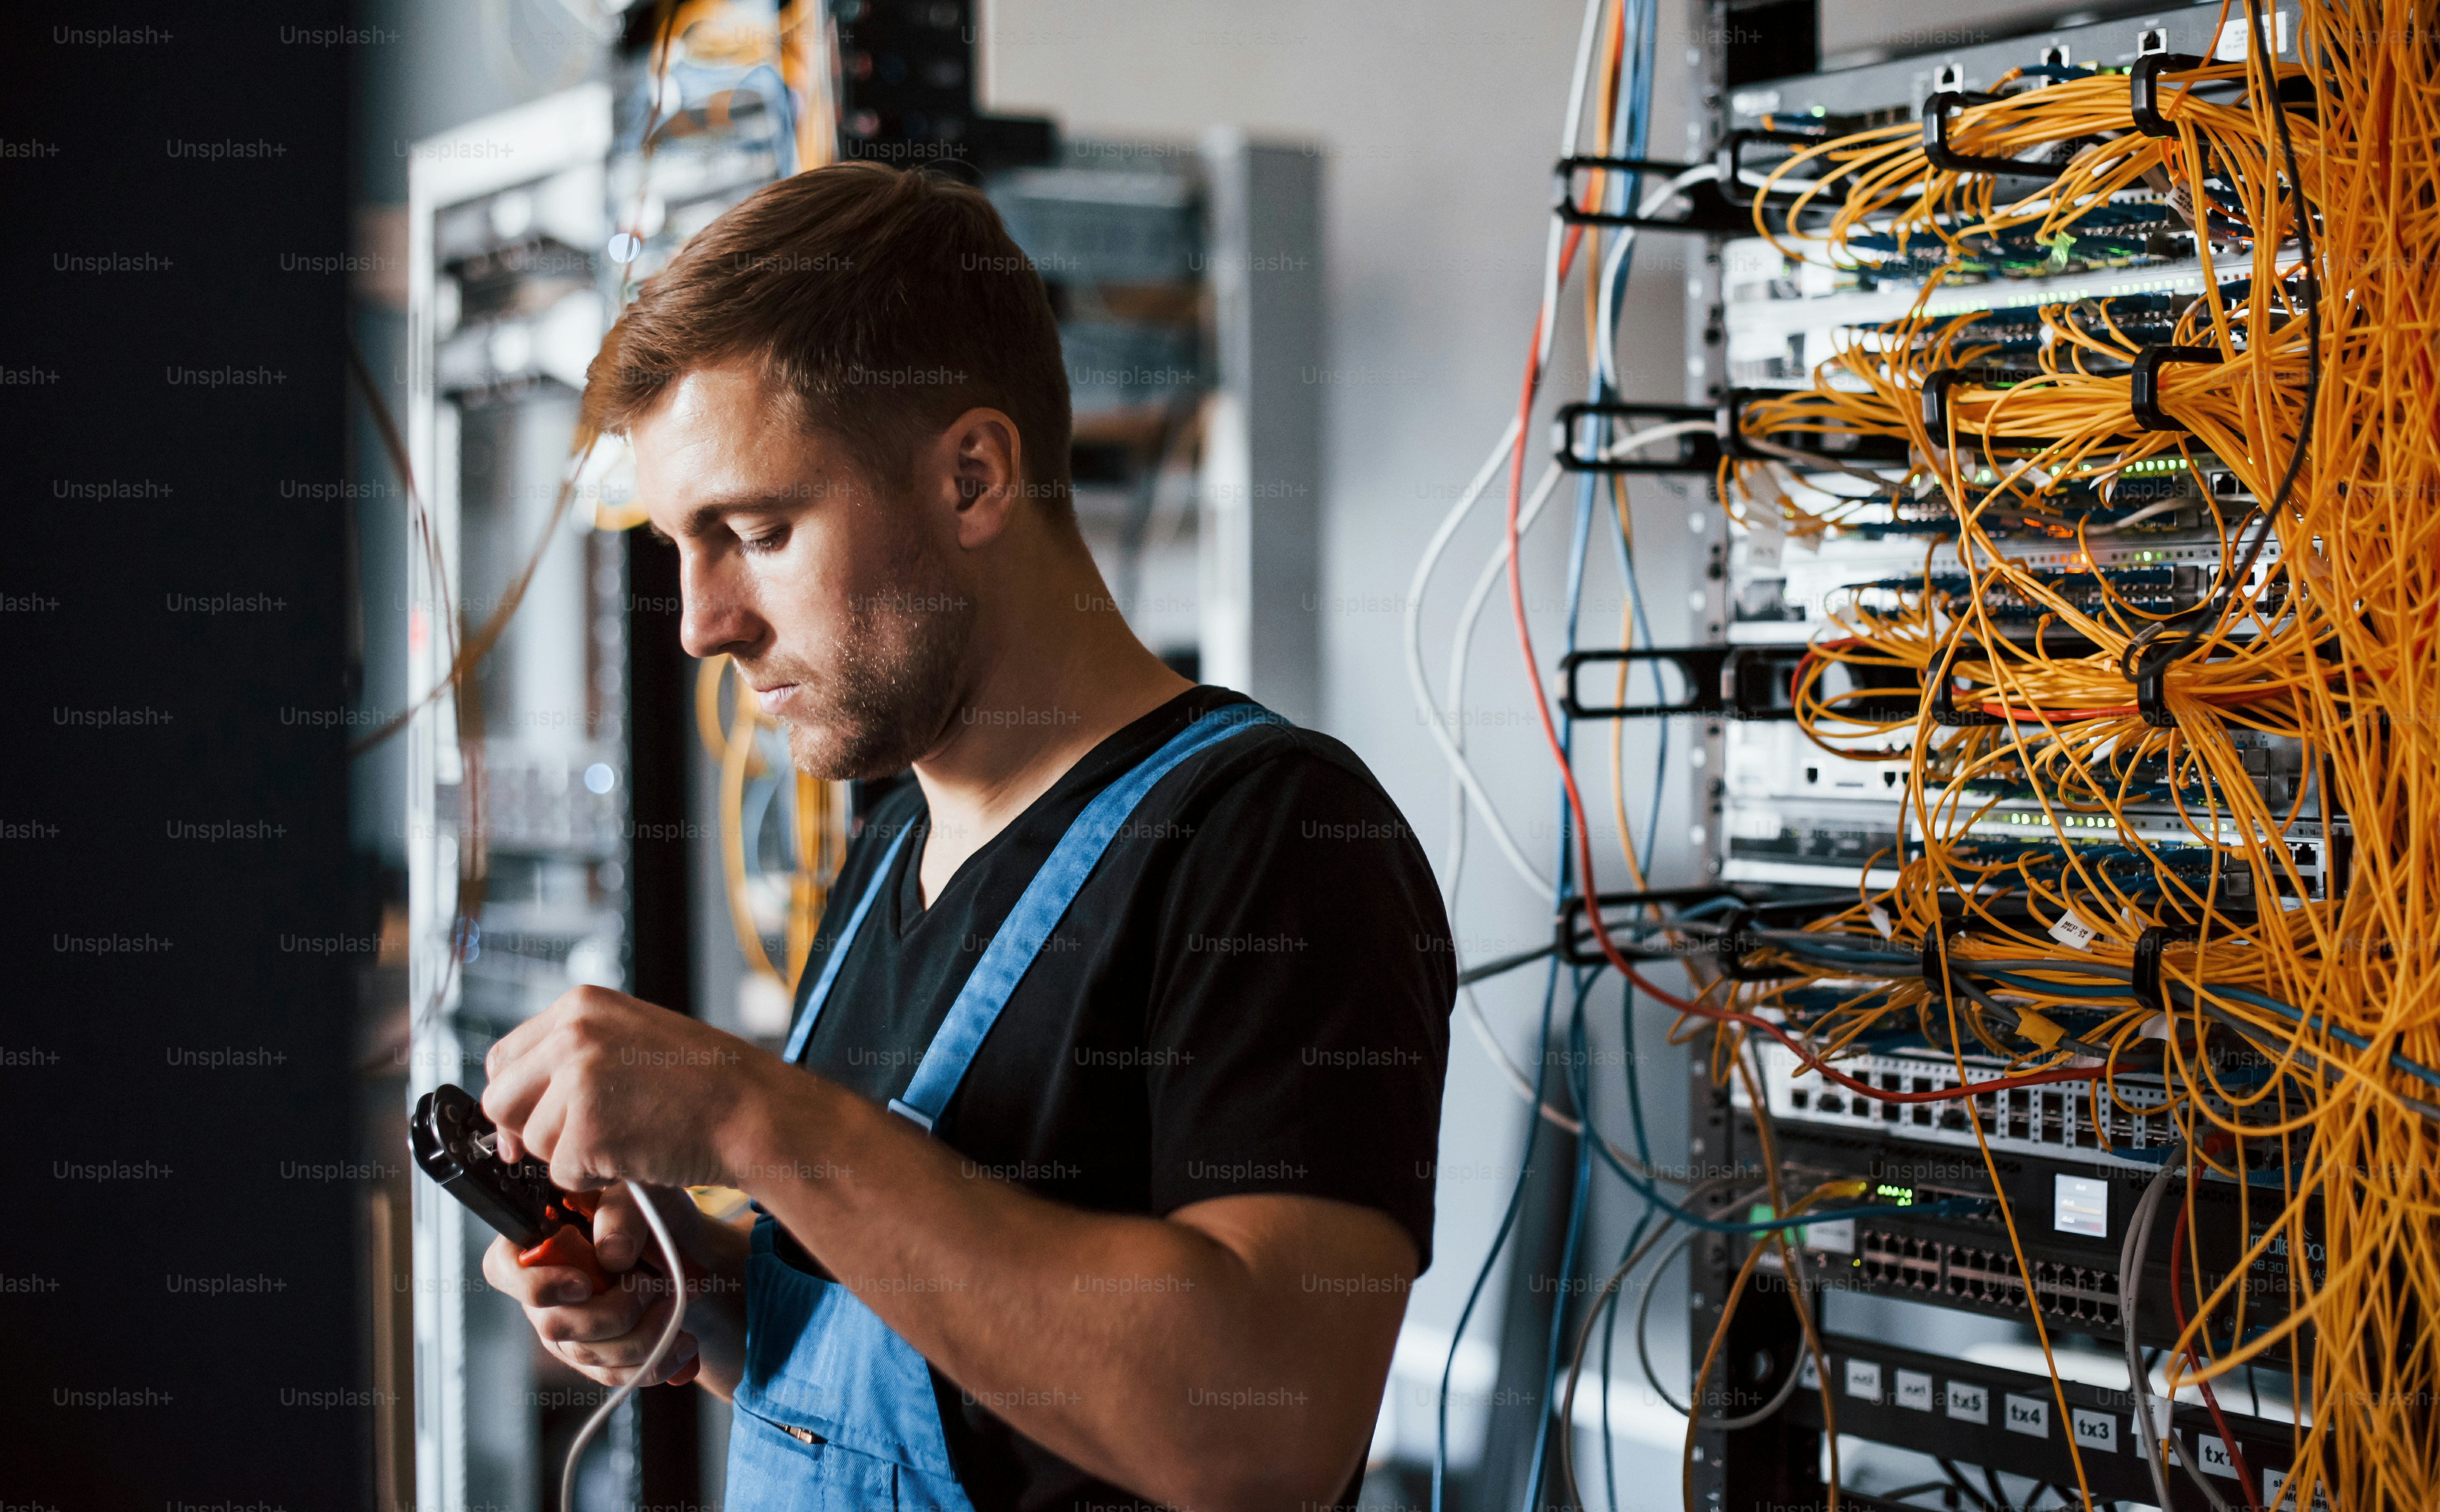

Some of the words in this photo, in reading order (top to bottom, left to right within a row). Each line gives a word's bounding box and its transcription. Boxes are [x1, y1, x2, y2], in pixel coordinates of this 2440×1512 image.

[1952, 1391, 1982, 1412] tx5
[2010, 1404, 2041, 1425] tx4
[2078, 1418, 2110, 1440] tx3
